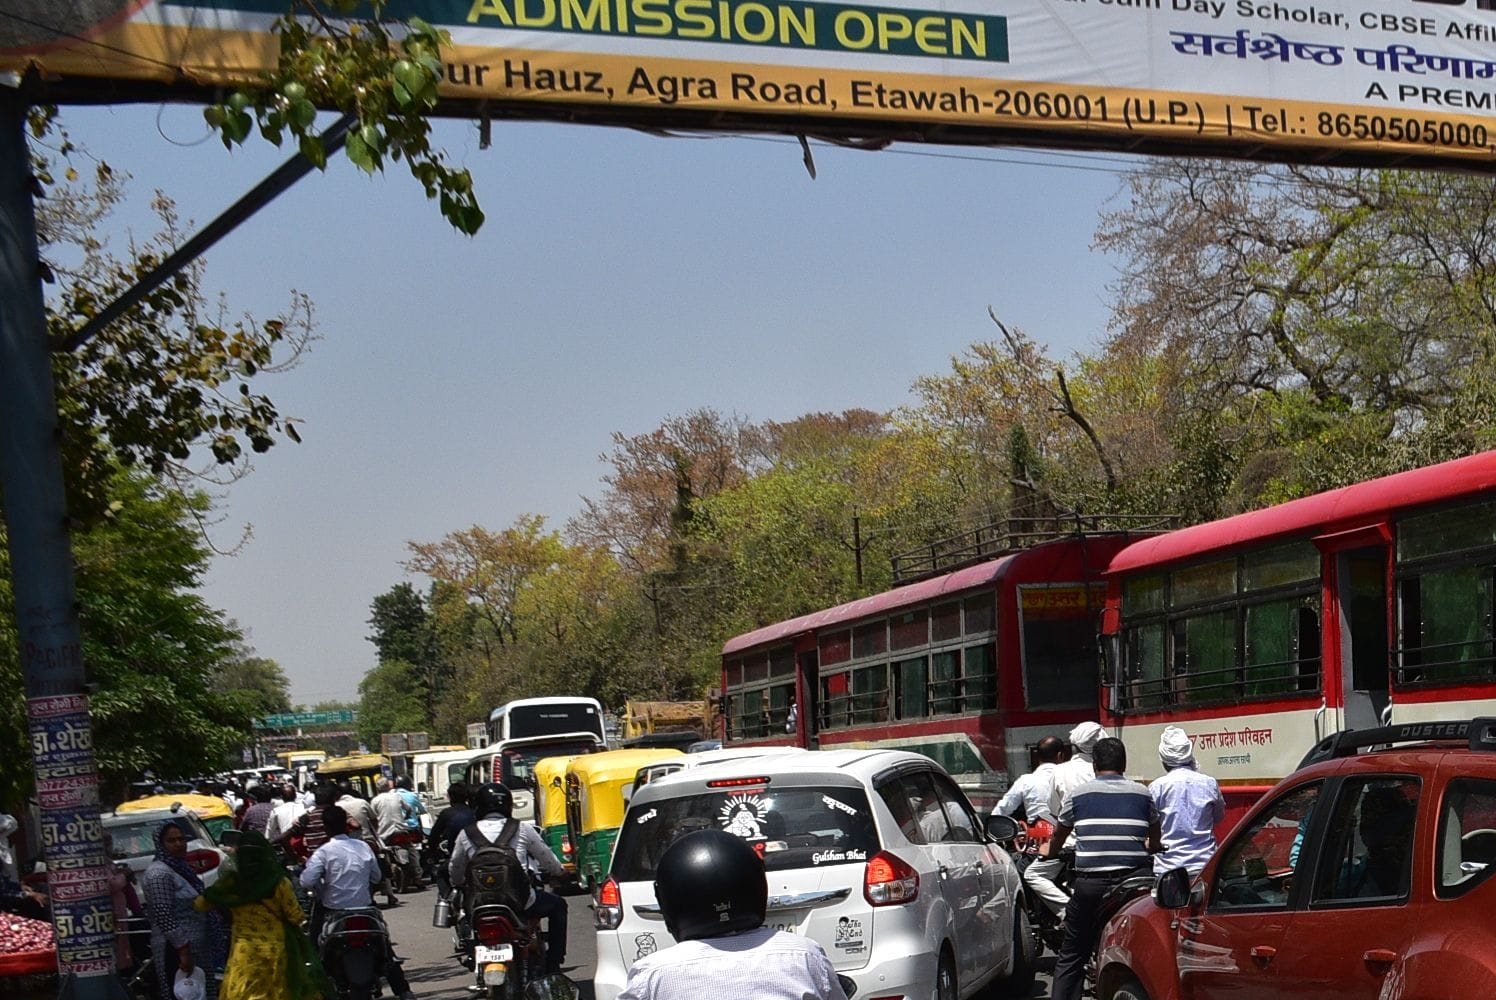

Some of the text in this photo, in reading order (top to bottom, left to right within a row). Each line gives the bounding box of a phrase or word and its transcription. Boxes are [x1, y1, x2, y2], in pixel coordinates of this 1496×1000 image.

[465, 0, 988, 57] ADMISSION OPEN
[1172, 0, 1225, 19] Day
[1237, 0, 1350, 30] Scholar,
[1360, 13, 1437, 36] CBSE
[1170, 30, 1345, 67] सर्वश्रेष्ठ
[447, 62, 490, 87] ur
[503, 59, 614, 100] Hauz,
[627, 66, 718, 104] Agra
[731, 72, 838, 111] Road,
[851, 80, 1109, 122] Etawah-206001
[1123, 96, 1204, 135] (U.P.)
[1243, 105, 1306, 135] Tel.:
[1317, 112, 1495, 153] 8650505000,
[1365, 82, 1389, 101] A
[1199, 733, 1217, 750] उत्तर
[1218, 727, 1236, 748] प्रदेश
[1238, 727, 1272, 747] परिवहन
[1401, 724, 1469, 737] DUSTER
[812, 848, 867, 865] Gulshan Bhai
